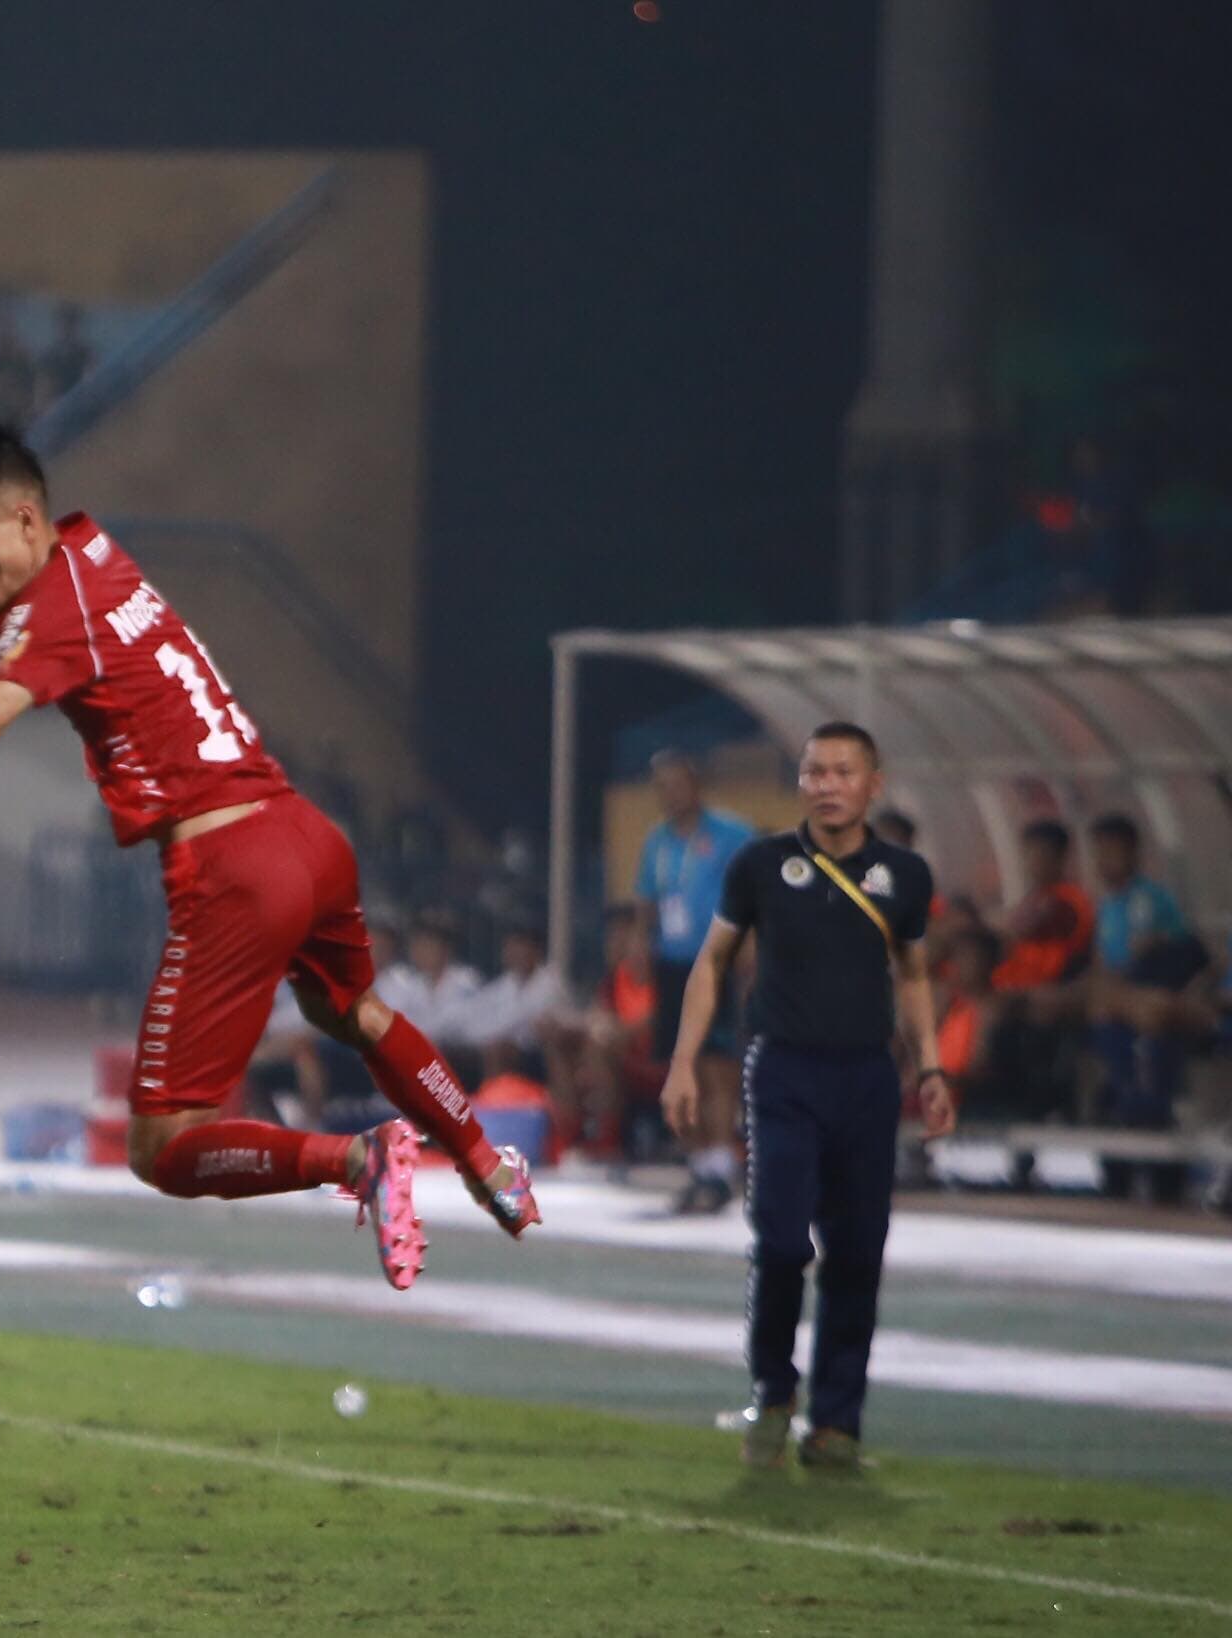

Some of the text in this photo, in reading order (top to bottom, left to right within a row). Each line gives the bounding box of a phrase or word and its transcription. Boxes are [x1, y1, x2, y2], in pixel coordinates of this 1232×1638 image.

[155, 627, 257, 762] 1
[138, 931, 188, 1089] JOGARBOLA
[417, 1059, 472, 1127] JOGARBOLA
